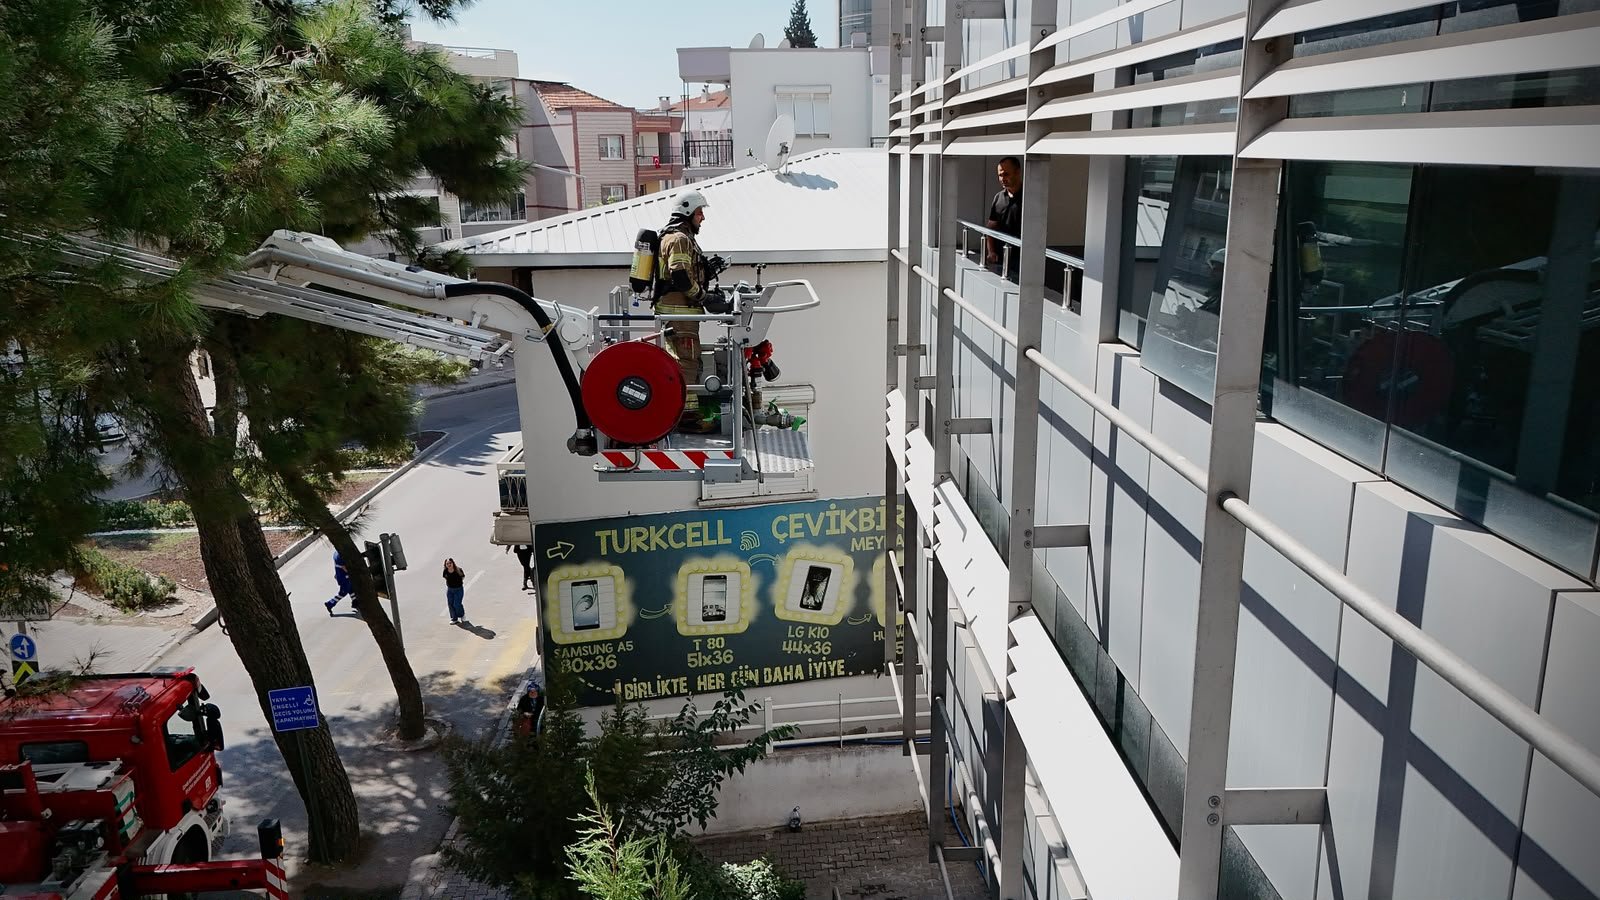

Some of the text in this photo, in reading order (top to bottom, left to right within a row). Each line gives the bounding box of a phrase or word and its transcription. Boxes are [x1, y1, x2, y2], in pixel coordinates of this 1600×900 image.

[595, 519, 732, 556] TURKCELL
[788, 625, 805, 638] LG
[553, 640, 634, 659] SAMSUNG A5
[693, 636, 725, 651] T 80
[782, 640, 832, 655] 44x36
[560, 654, 618, 674] 80x36
[687, 649, 734, 668] 51x36
[697, 672, 726, 691] HER
[763, 664, 805, 684] DAHA
